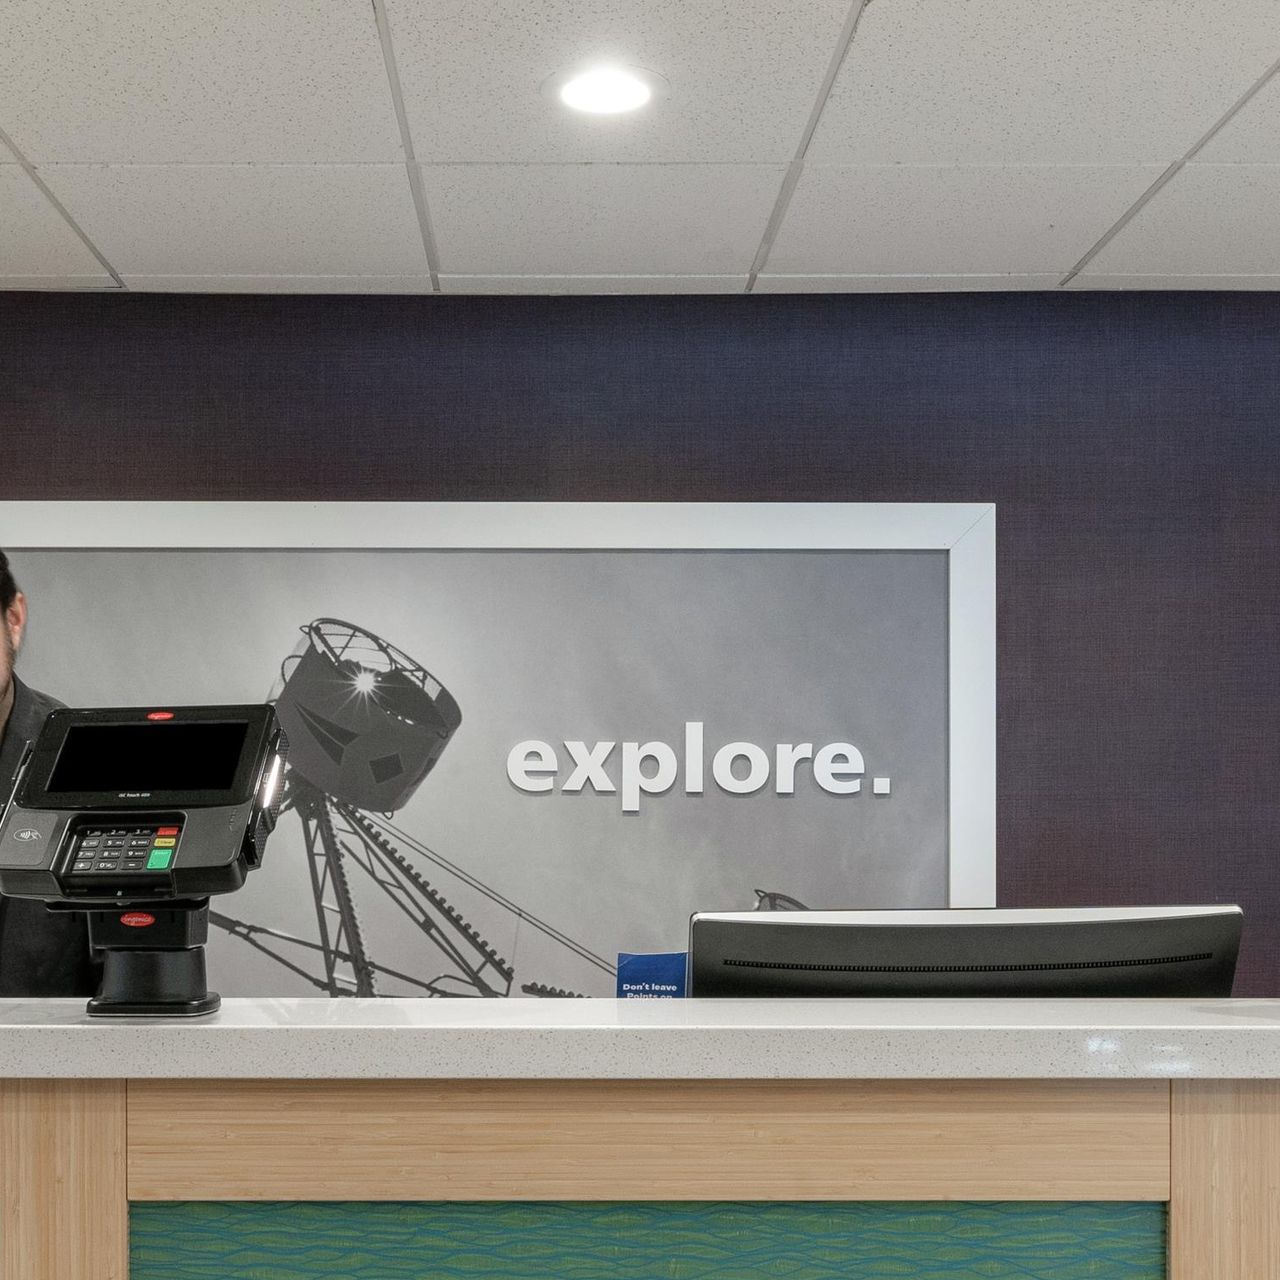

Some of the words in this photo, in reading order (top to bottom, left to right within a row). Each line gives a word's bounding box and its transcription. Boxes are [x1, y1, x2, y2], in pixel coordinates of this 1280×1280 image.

[506, 721, 891, 813] explore.
[622, 982, 650, 991] Don't
[651, 983, 678, 991] leave
